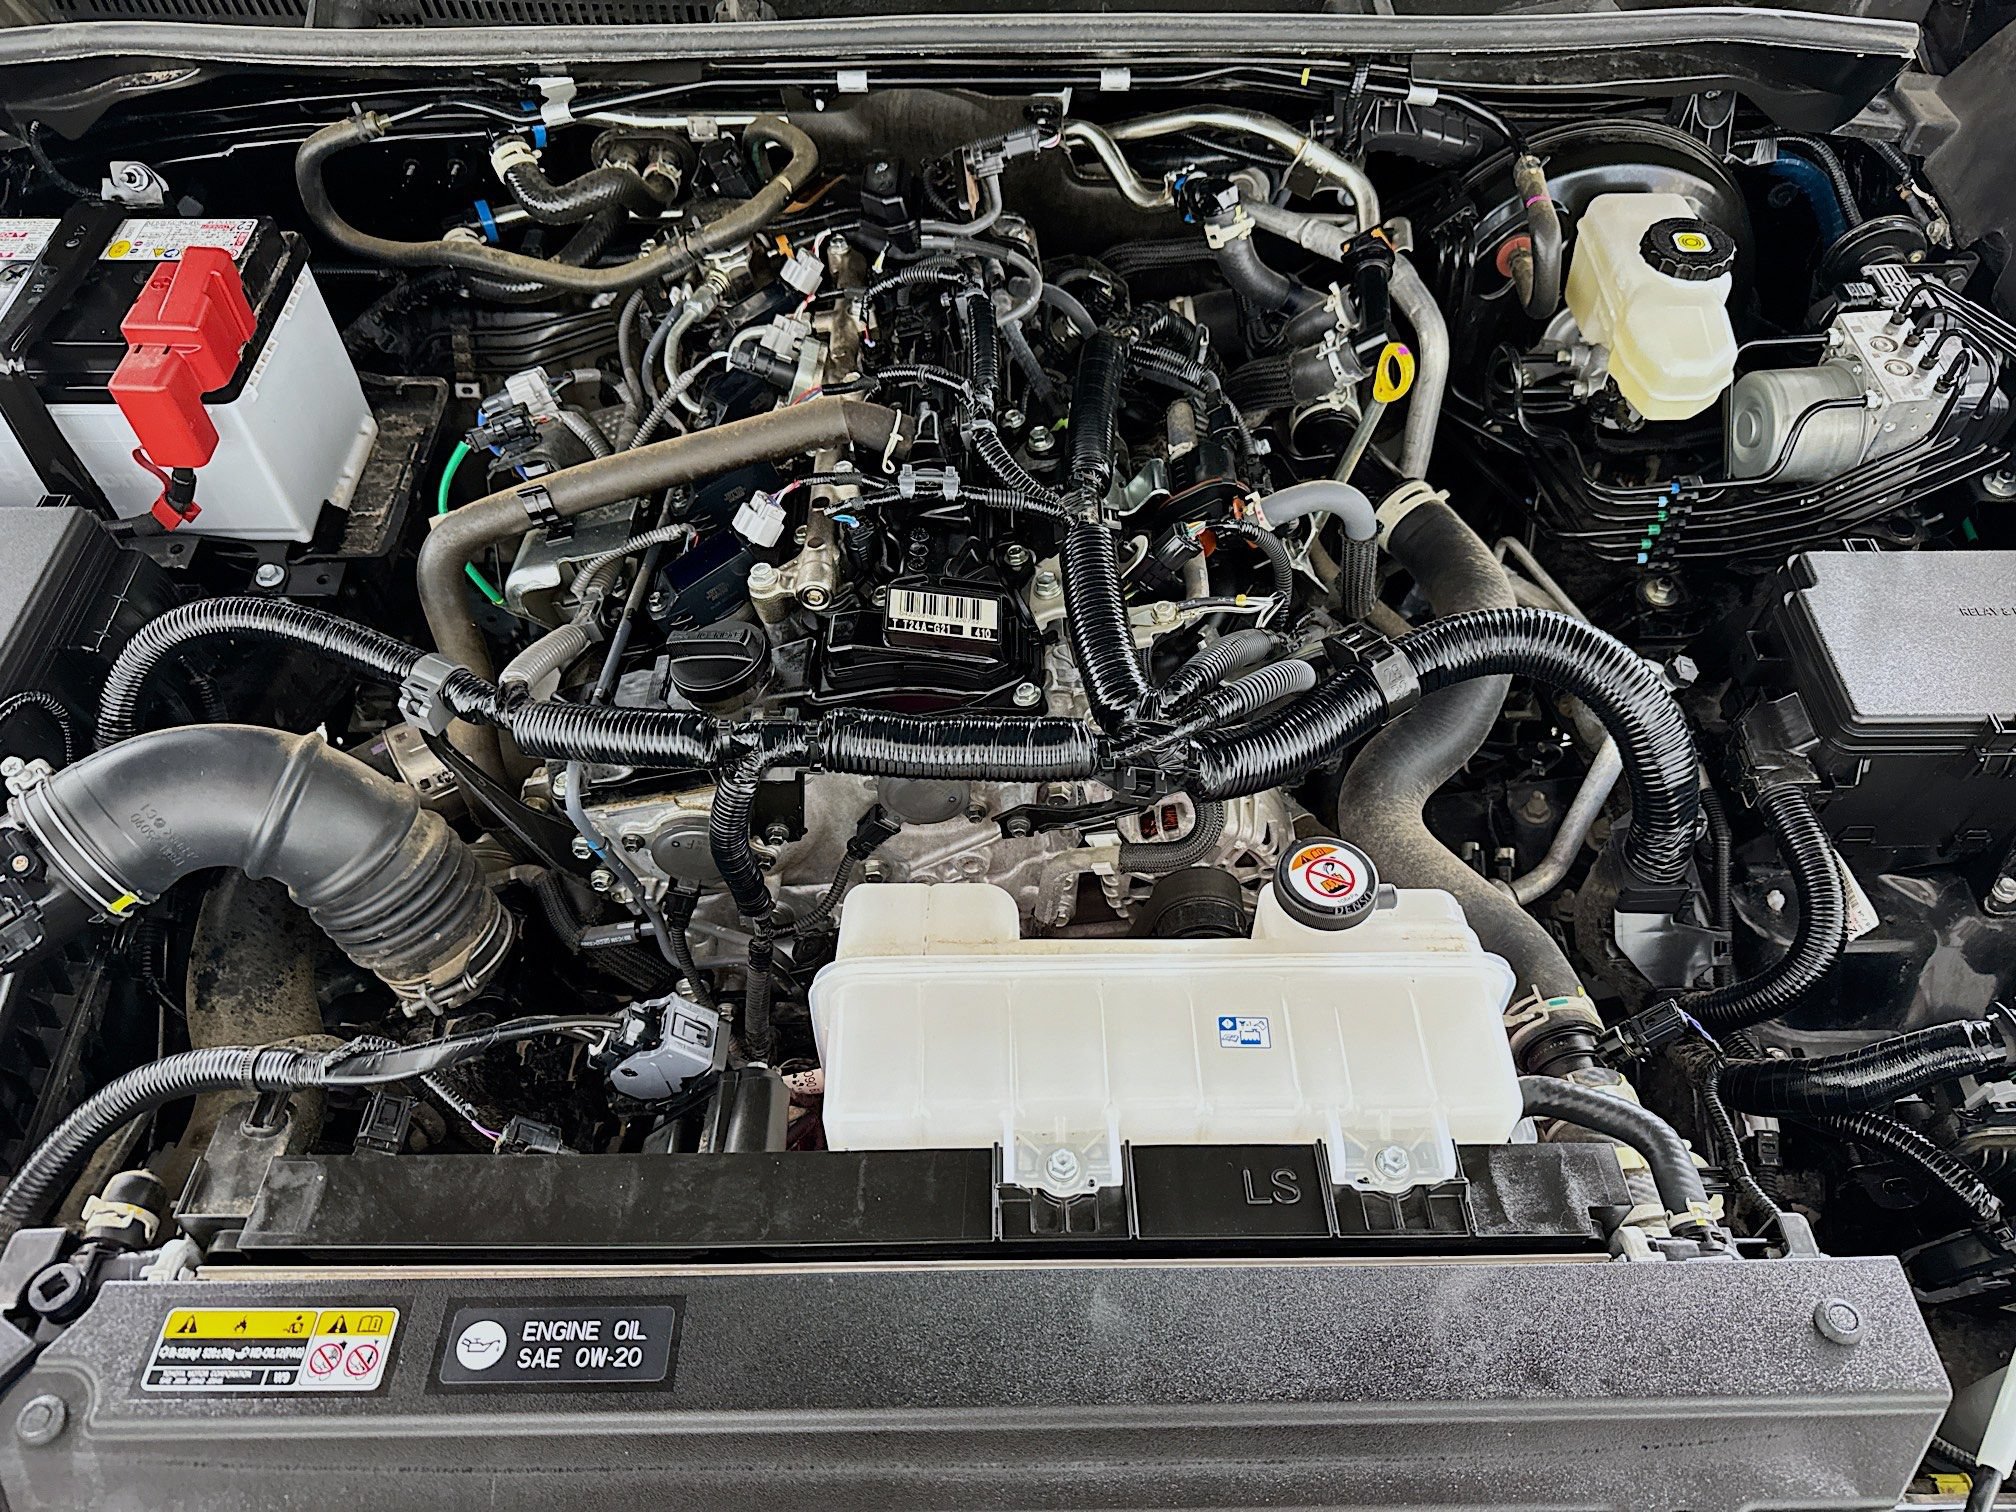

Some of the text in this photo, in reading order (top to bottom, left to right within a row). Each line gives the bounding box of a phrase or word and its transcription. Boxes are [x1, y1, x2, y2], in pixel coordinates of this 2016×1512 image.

[1959, 607, 1998, 617] RELAY
[974, 628, 992, 639] 410
[1334, 891, 1373, 916] DENSO
[1242, 1168, 1302, 1205] LS
[522, 1320, 648, 1342] ENGINE OIL
[516, 1346, 643, 1369] SAE 0W-20
